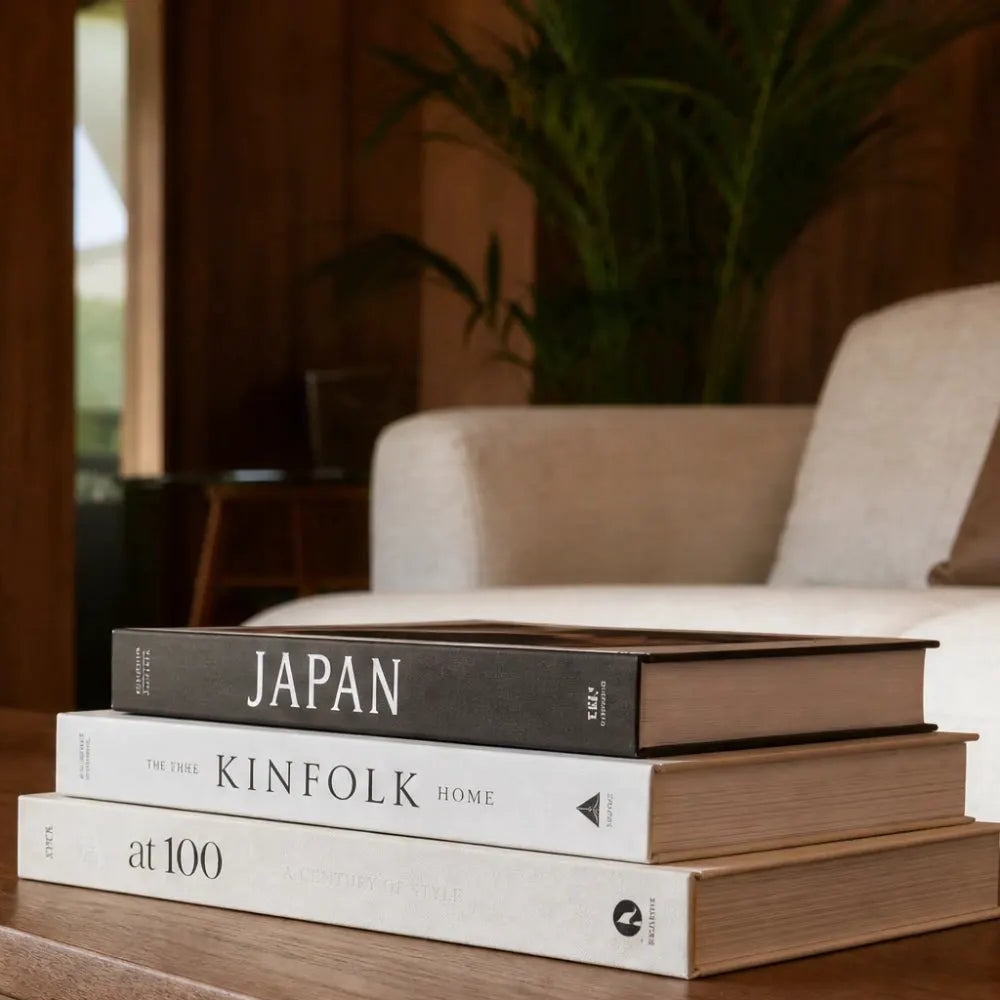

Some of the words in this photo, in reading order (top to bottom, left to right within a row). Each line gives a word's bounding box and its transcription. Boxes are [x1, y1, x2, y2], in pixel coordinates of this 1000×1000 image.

[247, 650, 401, 716] JAPAN
[215, 754, 420, 808] KINFOLK
[437, 786, 495, 806] HOME
[128, 837, 156, 870] at
[163, 836, 223, 880] 100
